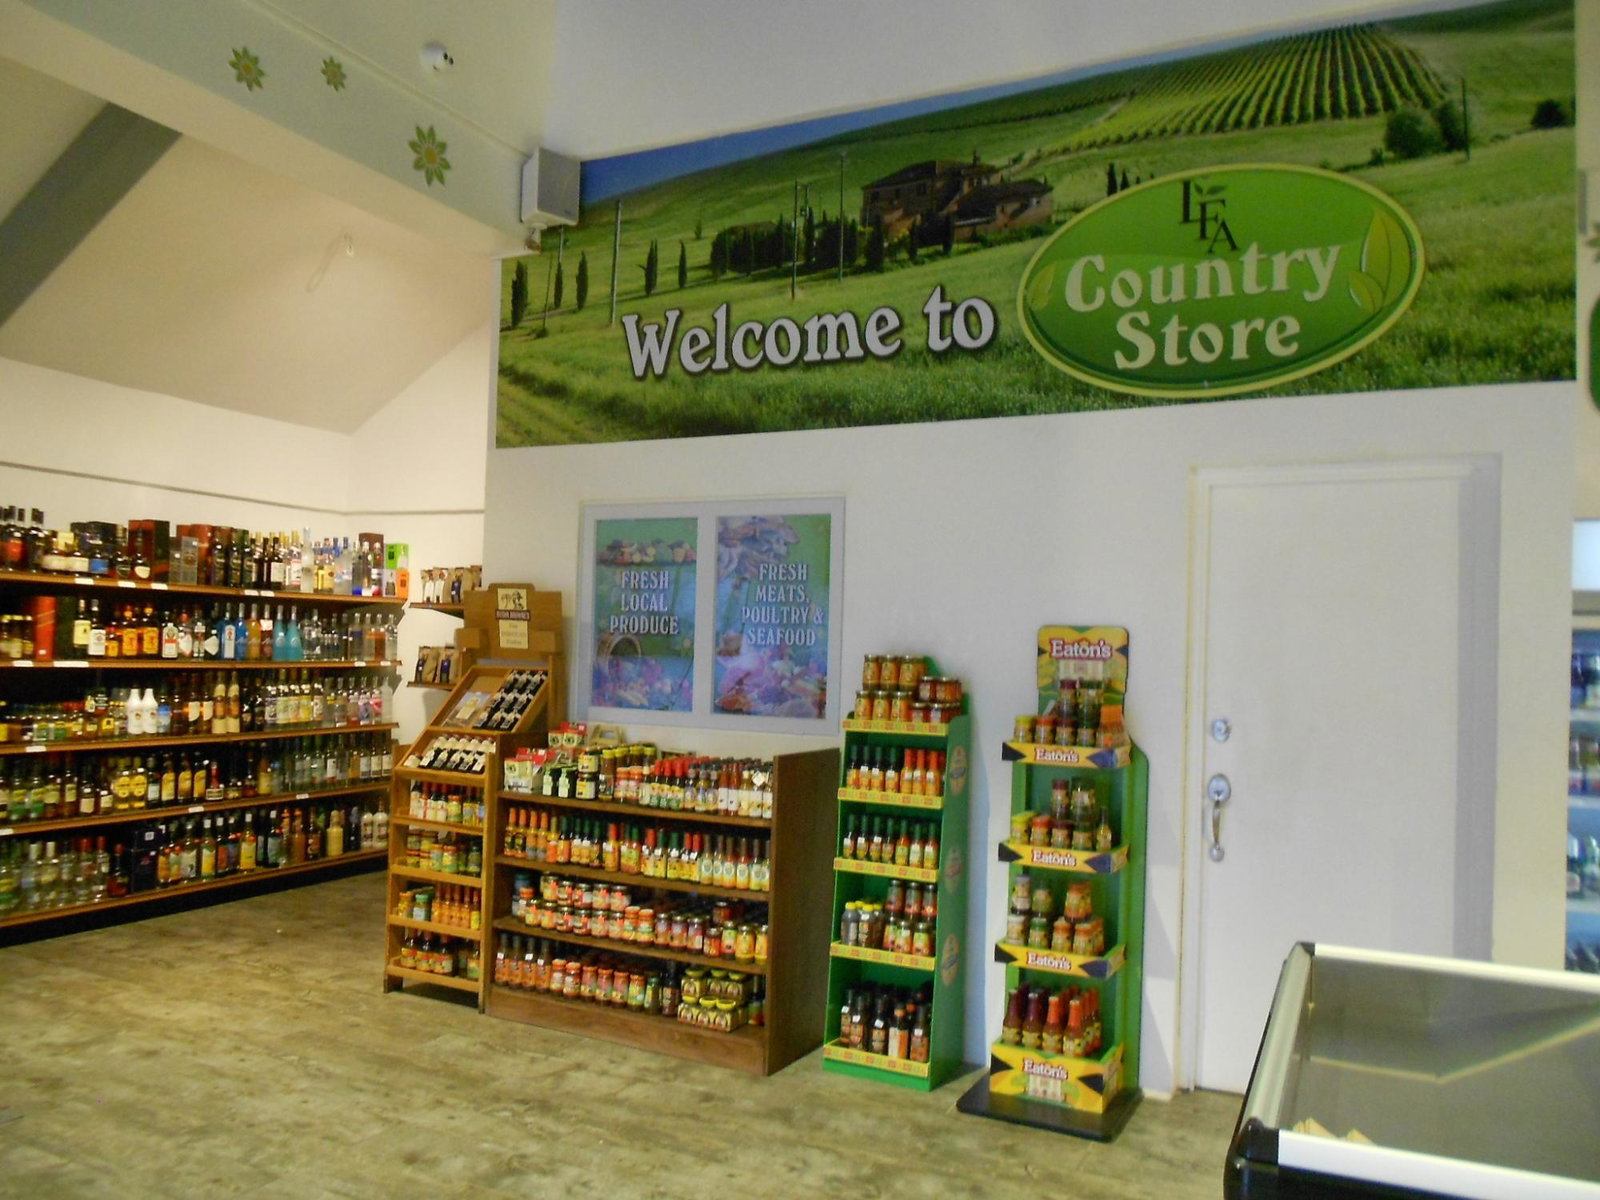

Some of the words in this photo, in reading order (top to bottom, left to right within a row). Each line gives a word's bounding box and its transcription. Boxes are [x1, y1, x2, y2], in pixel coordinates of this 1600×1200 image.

[1064, 241, 1342, 313] Country
[621, 302, 902, 378] Welcome
[922, 285, 995, 352] to
[1113, 310, 1301, 370] Store
[620, 569, 670, 591] FRESH
[759, 563, 809, 581] FRESH
[620, 592, 668, 613] LOCAL
[609, 614, 679, 635] PRODUCE
[741, 605, 810, 625] POULTRY
[813, 608, 825, 625] &
[747, 627, 817, 647] SEAFOOD
[1050, 638, 1112, 659] Eaton's
[1035, 747, 1079, 763] Eaton's
[1027, 952, 1072, 971] Eaton's
